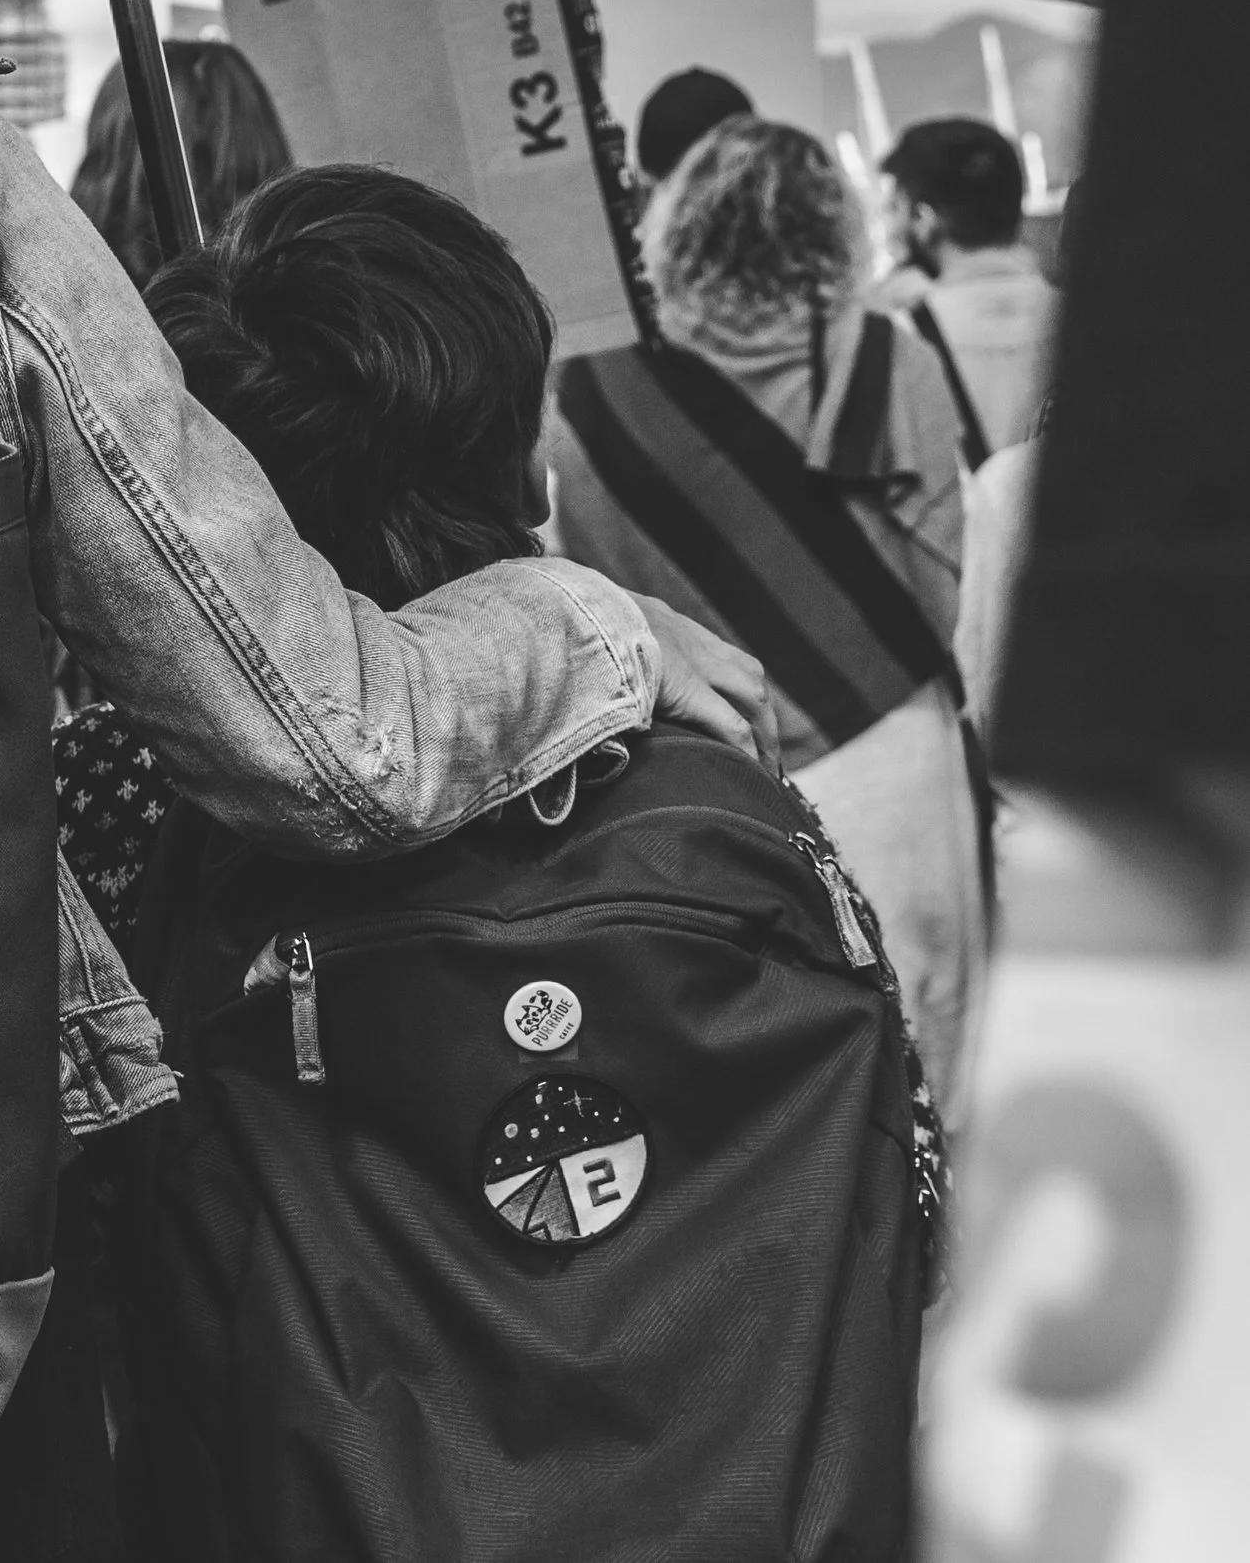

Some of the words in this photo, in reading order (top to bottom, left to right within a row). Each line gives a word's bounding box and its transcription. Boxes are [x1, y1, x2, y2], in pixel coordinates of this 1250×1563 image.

[510, 71, 567, 157] K3
[531, 998, 573, 1047] PURRRIDE
[582, 1157, 621, 1208] 2
